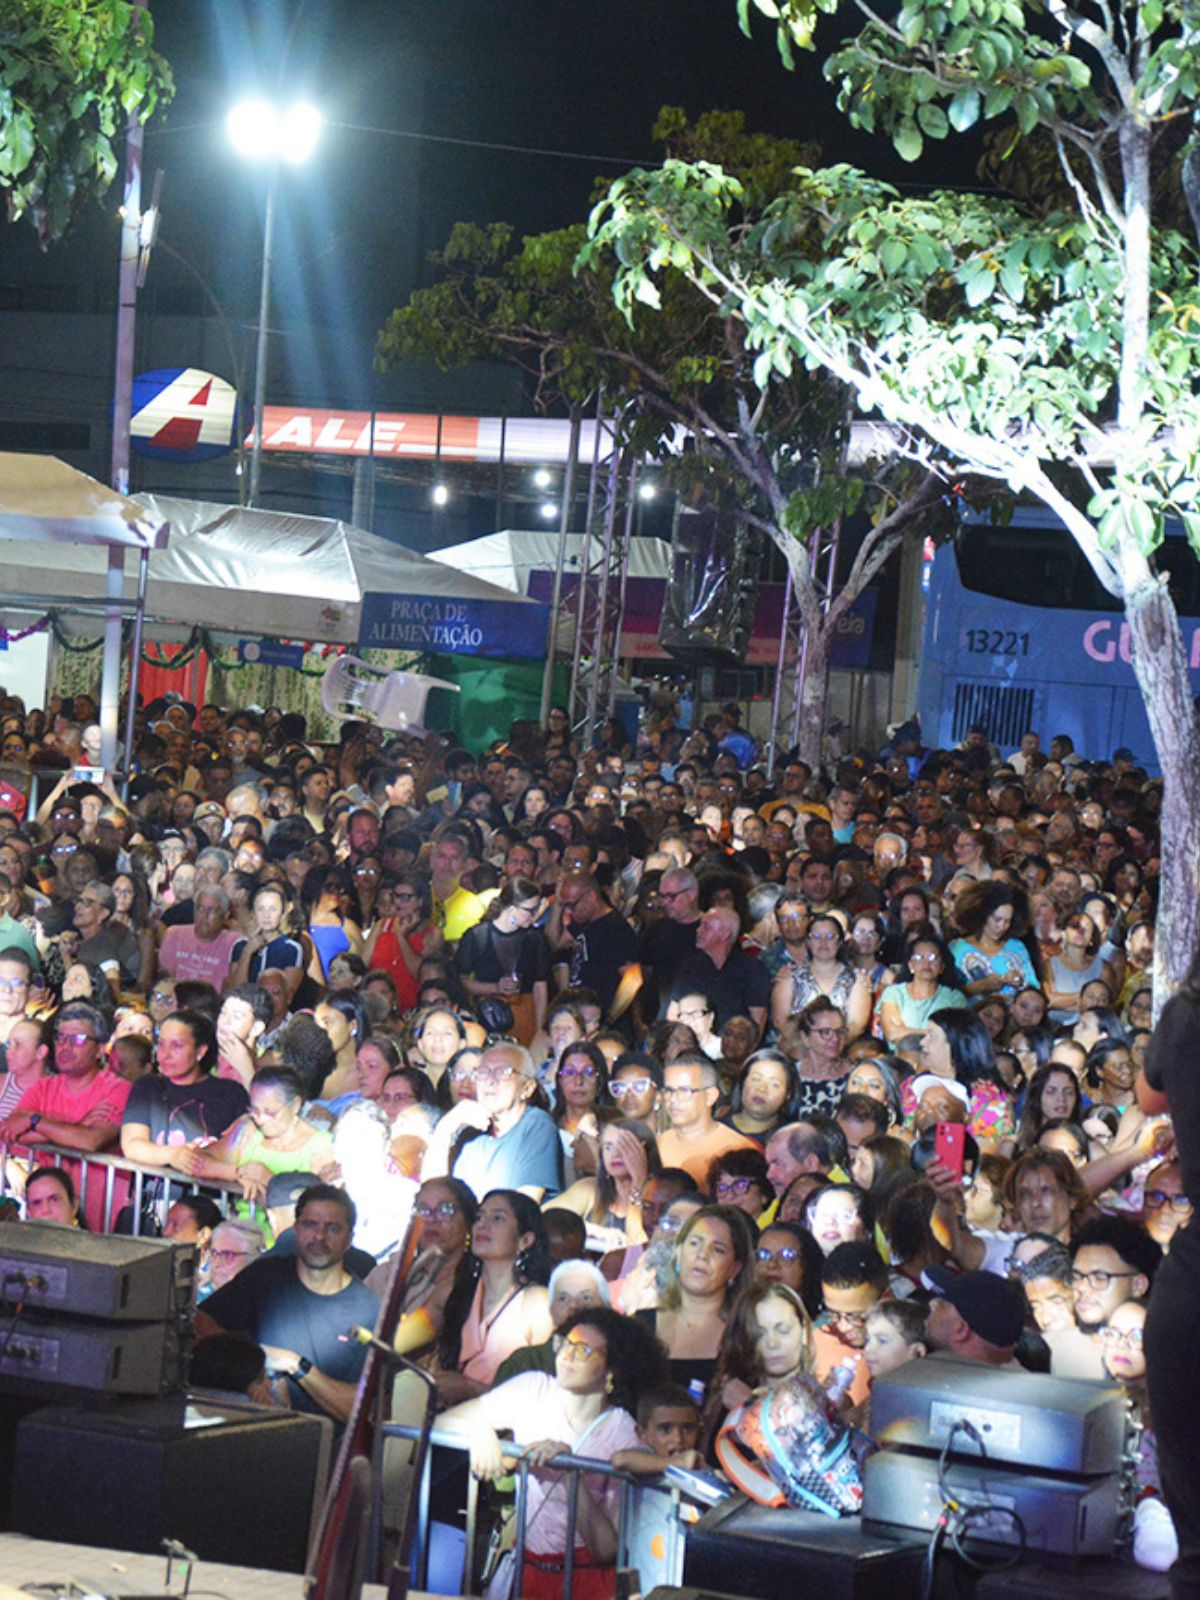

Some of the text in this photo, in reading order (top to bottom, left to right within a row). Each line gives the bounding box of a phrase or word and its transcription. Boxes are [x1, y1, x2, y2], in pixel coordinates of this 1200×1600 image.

[265, 415, 406, 452] ALE
[390, 601, 468, 626] PRAÇA DE
[368, 621, 483, 650] ALIMENTAÇÃO
[966, 629, 1030, 656] 13221
